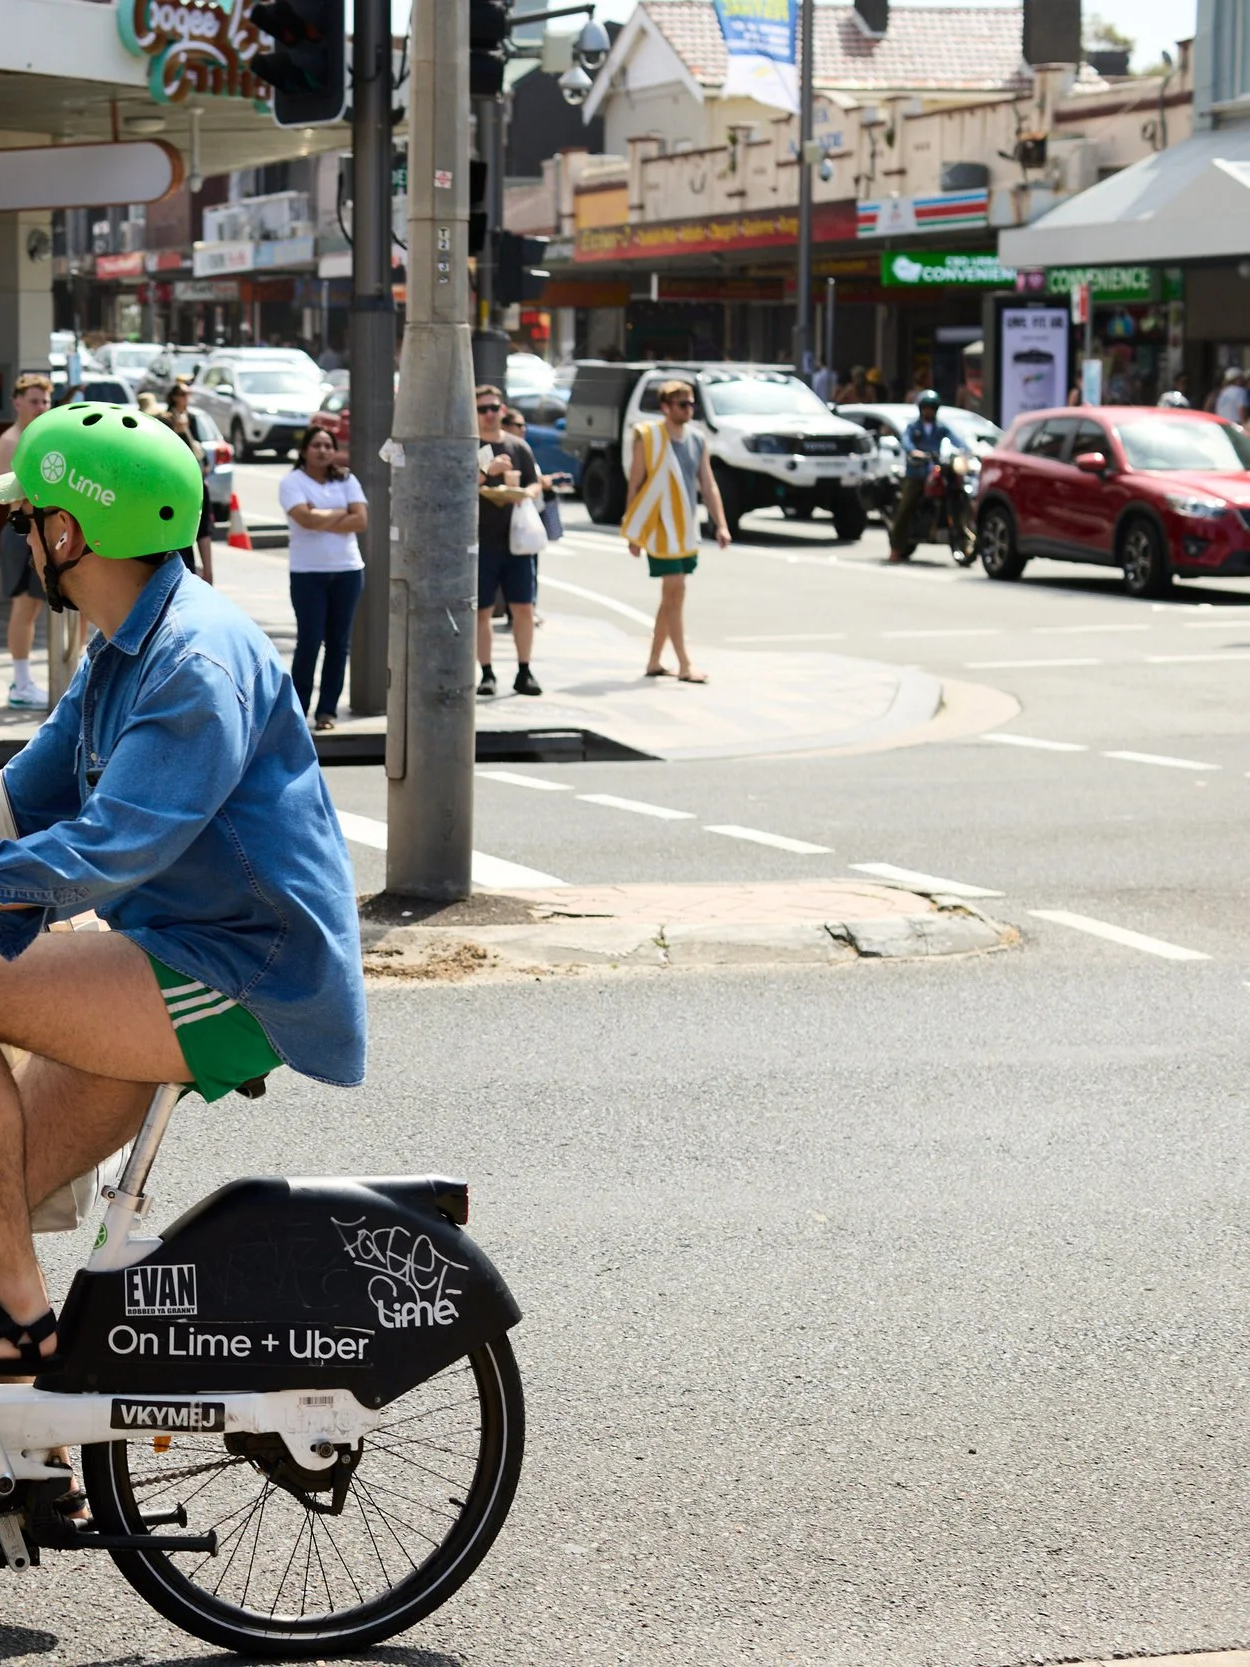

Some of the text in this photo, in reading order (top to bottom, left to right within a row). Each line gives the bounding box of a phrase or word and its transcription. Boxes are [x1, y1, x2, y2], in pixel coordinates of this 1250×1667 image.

[922, 265, 1017, 282] CONVENIEN
[1050, 267, 1150, 293] CONVENIENCE
[68, 468, 116, 507] Lime
[126, 1266, 196, 1308] EVAN
[108, 1325, 370, 1360] On Lime + Uber
